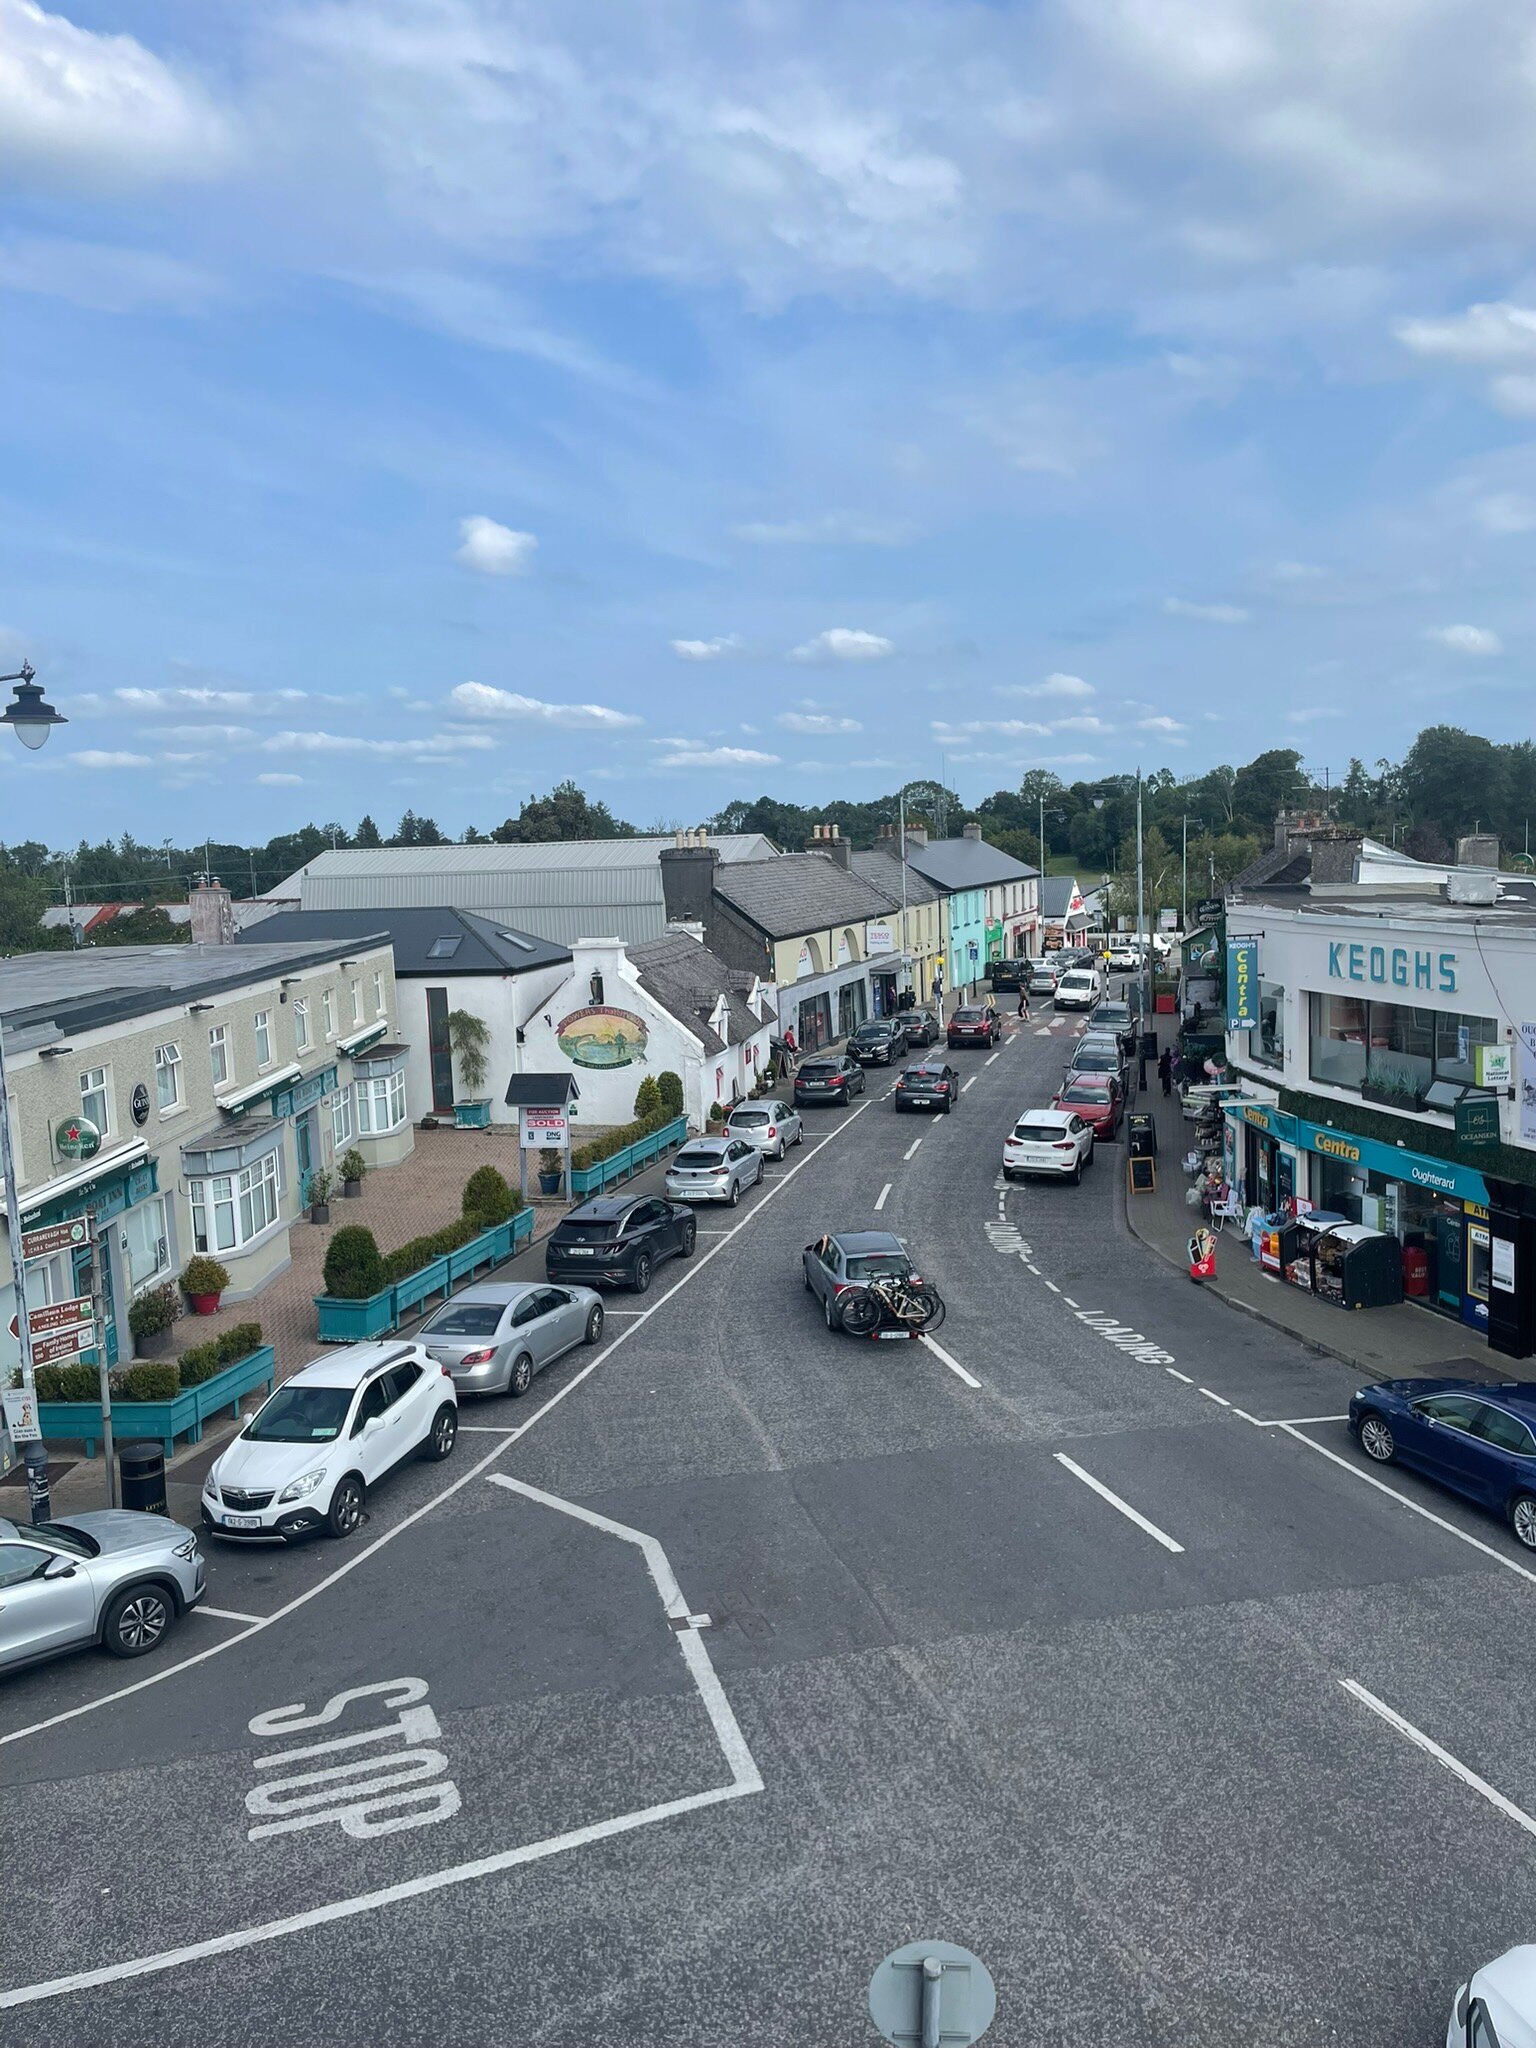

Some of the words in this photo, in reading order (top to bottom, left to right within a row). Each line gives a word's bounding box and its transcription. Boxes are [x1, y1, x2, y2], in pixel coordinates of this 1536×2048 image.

[1329, 942, 1456, 993] KEOGHS
[1237, 950, 1249, 1017] Centra
[562, 1008, 596, 1027] POWERS
[1243, 1106, 1269, 1129] Centra
[59, 1142, 95, 1150] Heineken
[1314, 1133, 1360, 1161] Centra
[1460, 1132, 1497, 1141] OCEANSKIN
[1412, 1167, 1455, 1190] Oughterard
[60, 1304, 79, 1313] Lodge
[37, 1321, 59, 1330] ANGLING
[42, 1338, 60, 1348] Family
[60, 1332, 77, 1343] Homes
[55, 1340, 73, 1351] Ireland
[1073, 1310, 1176, 1365] LOADING
[245, 1676, 462, 1842] STOP
